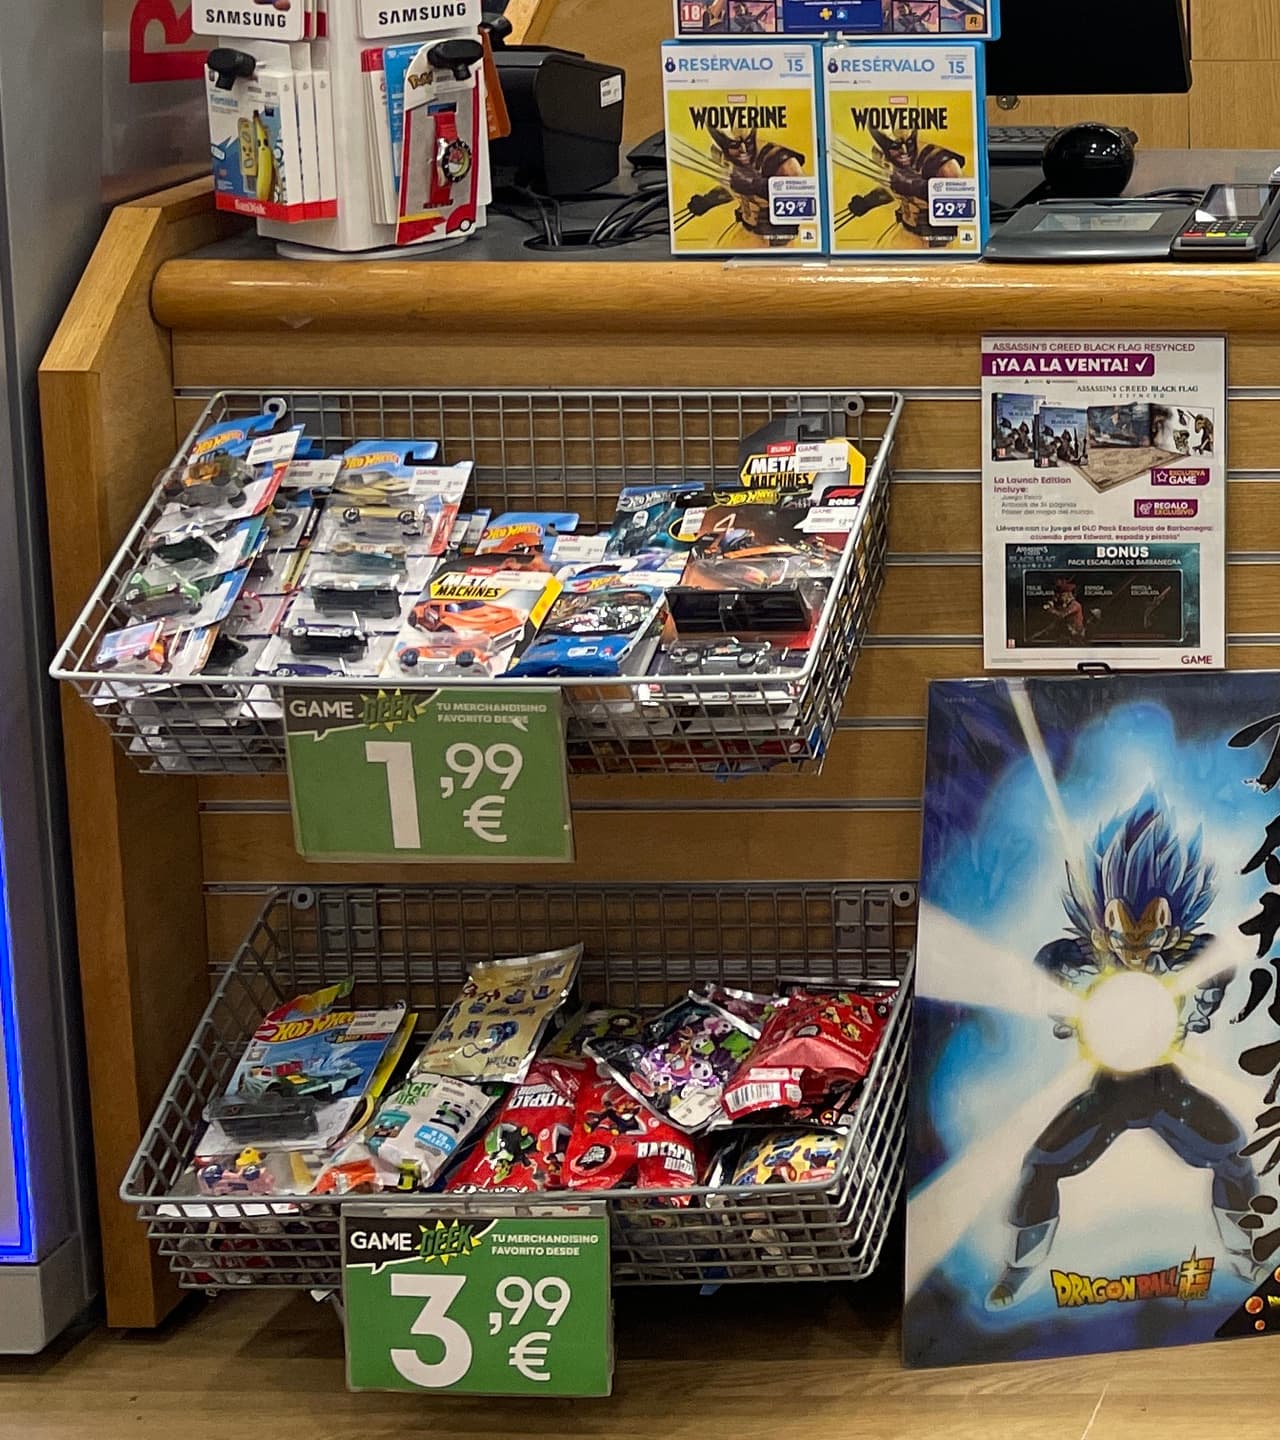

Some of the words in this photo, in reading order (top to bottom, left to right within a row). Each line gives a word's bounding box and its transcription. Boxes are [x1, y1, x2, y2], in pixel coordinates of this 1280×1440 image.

[206, 8, 287, 28] SAMSUNG
[378, 3, 467, 26] SAMSUNG
[678, 55, 774, 73] RESÉRVALO
[786, 59, 804, 72] 15
[688, 105, 788, 130] WOLVERINE
[1050, 343, 1082, 351] CREED
[1084, 343, 1115, 351] BLACK
[1117, 343, 1142, 351] FLAG
[1144, 343, 1195, 351] RESYNCED
[991, 359, 1021, 374] ¡YA
[1022, 359, 1036, 371] A
[1040, 359, 1063, 371] LA
[1065, 359, 1129, 372] VENTA!
[1097, 547, 1149, 558] BONUS
[435, 587, 501, 597] MACHINES
[1181, 655, 1212, 665] GAME
[288, 698, 355, 721] GAME
[350, 1230, 412, 1251] GAME
[492, 1234, 502, 1243] TU
[505, 1234, 598, 1245] MERCHANDISING
[492, 1246, 544, 1256] FAVORITO
[546, 1246, 580, 1256] DESDE
[1050, 1270, 1137, 1308] DRAGON
